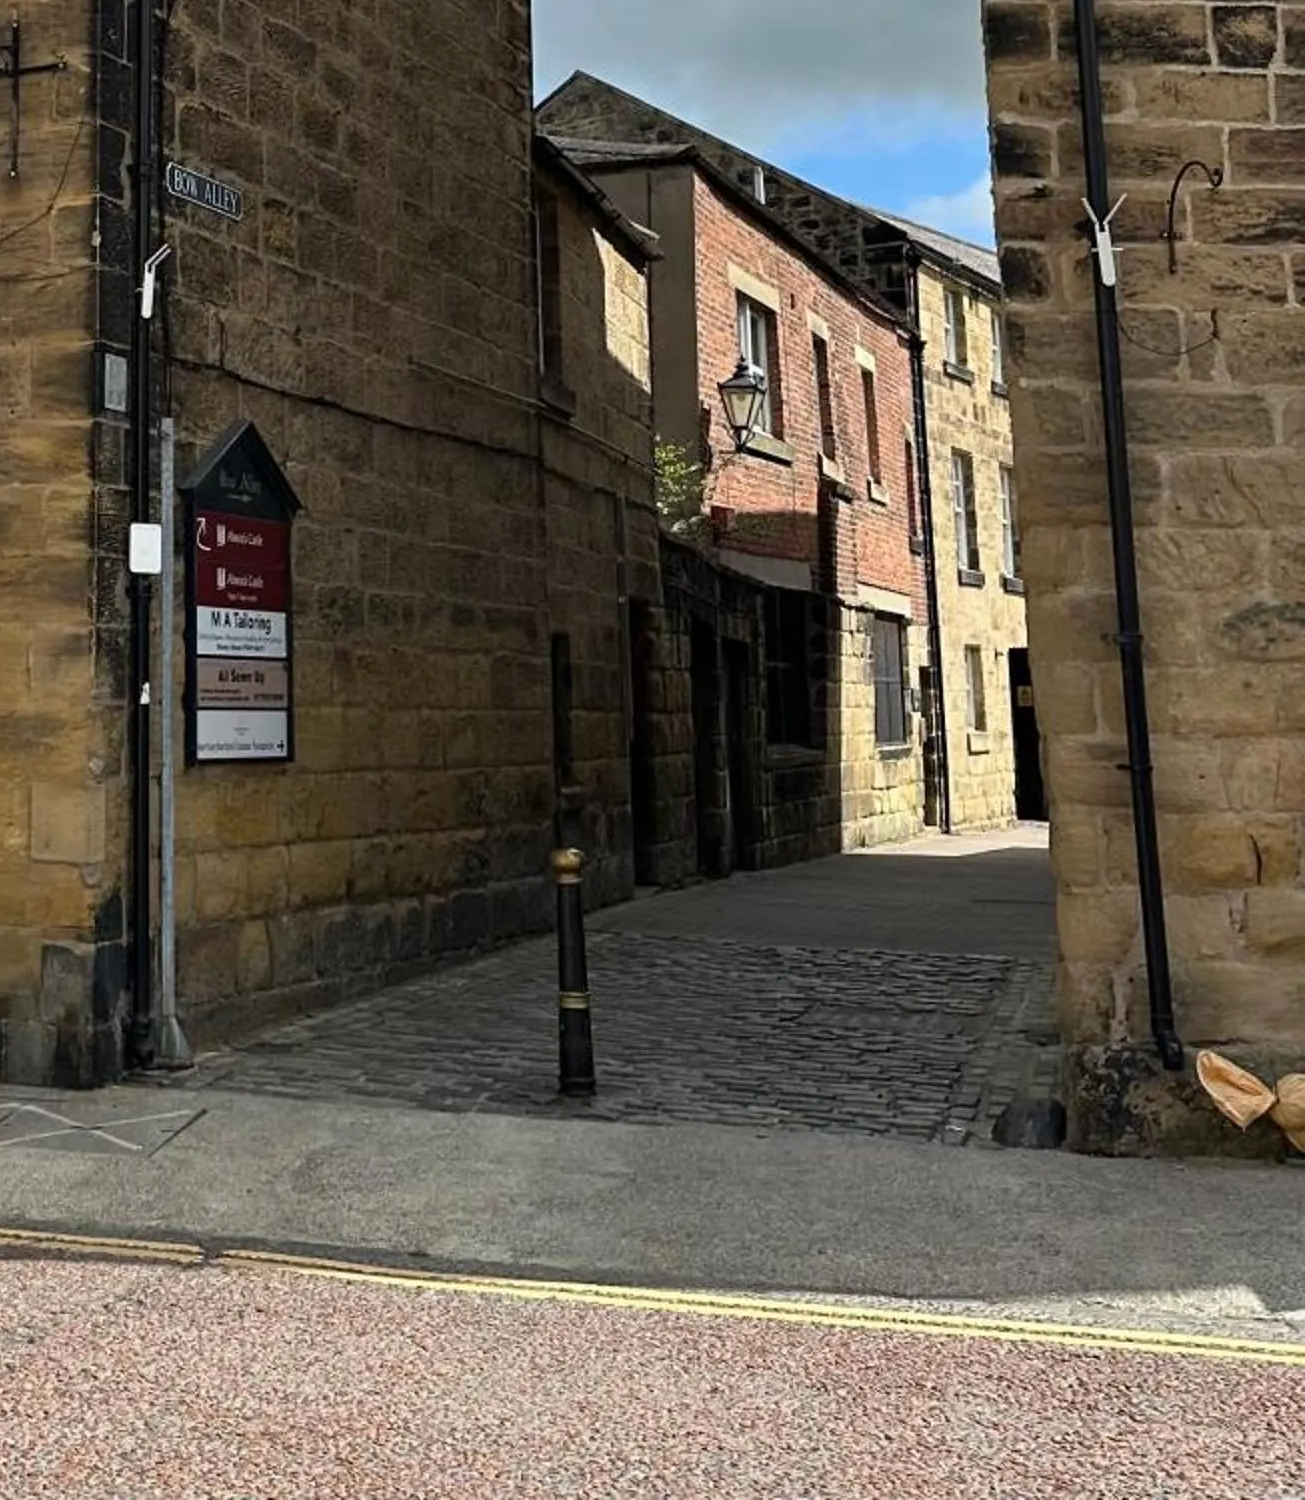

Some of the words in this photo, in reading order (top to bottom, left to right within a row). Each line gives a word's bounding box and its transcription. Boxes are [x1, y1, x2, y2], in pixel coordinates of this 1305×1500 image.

[174, 169, 198, 198] BOW
[204, 182, 238, 212] ALLEY
[211, 611, 221, 628] M
[223, 612, 231, 628] A
[232, 612, 272, 635] Tailoring
